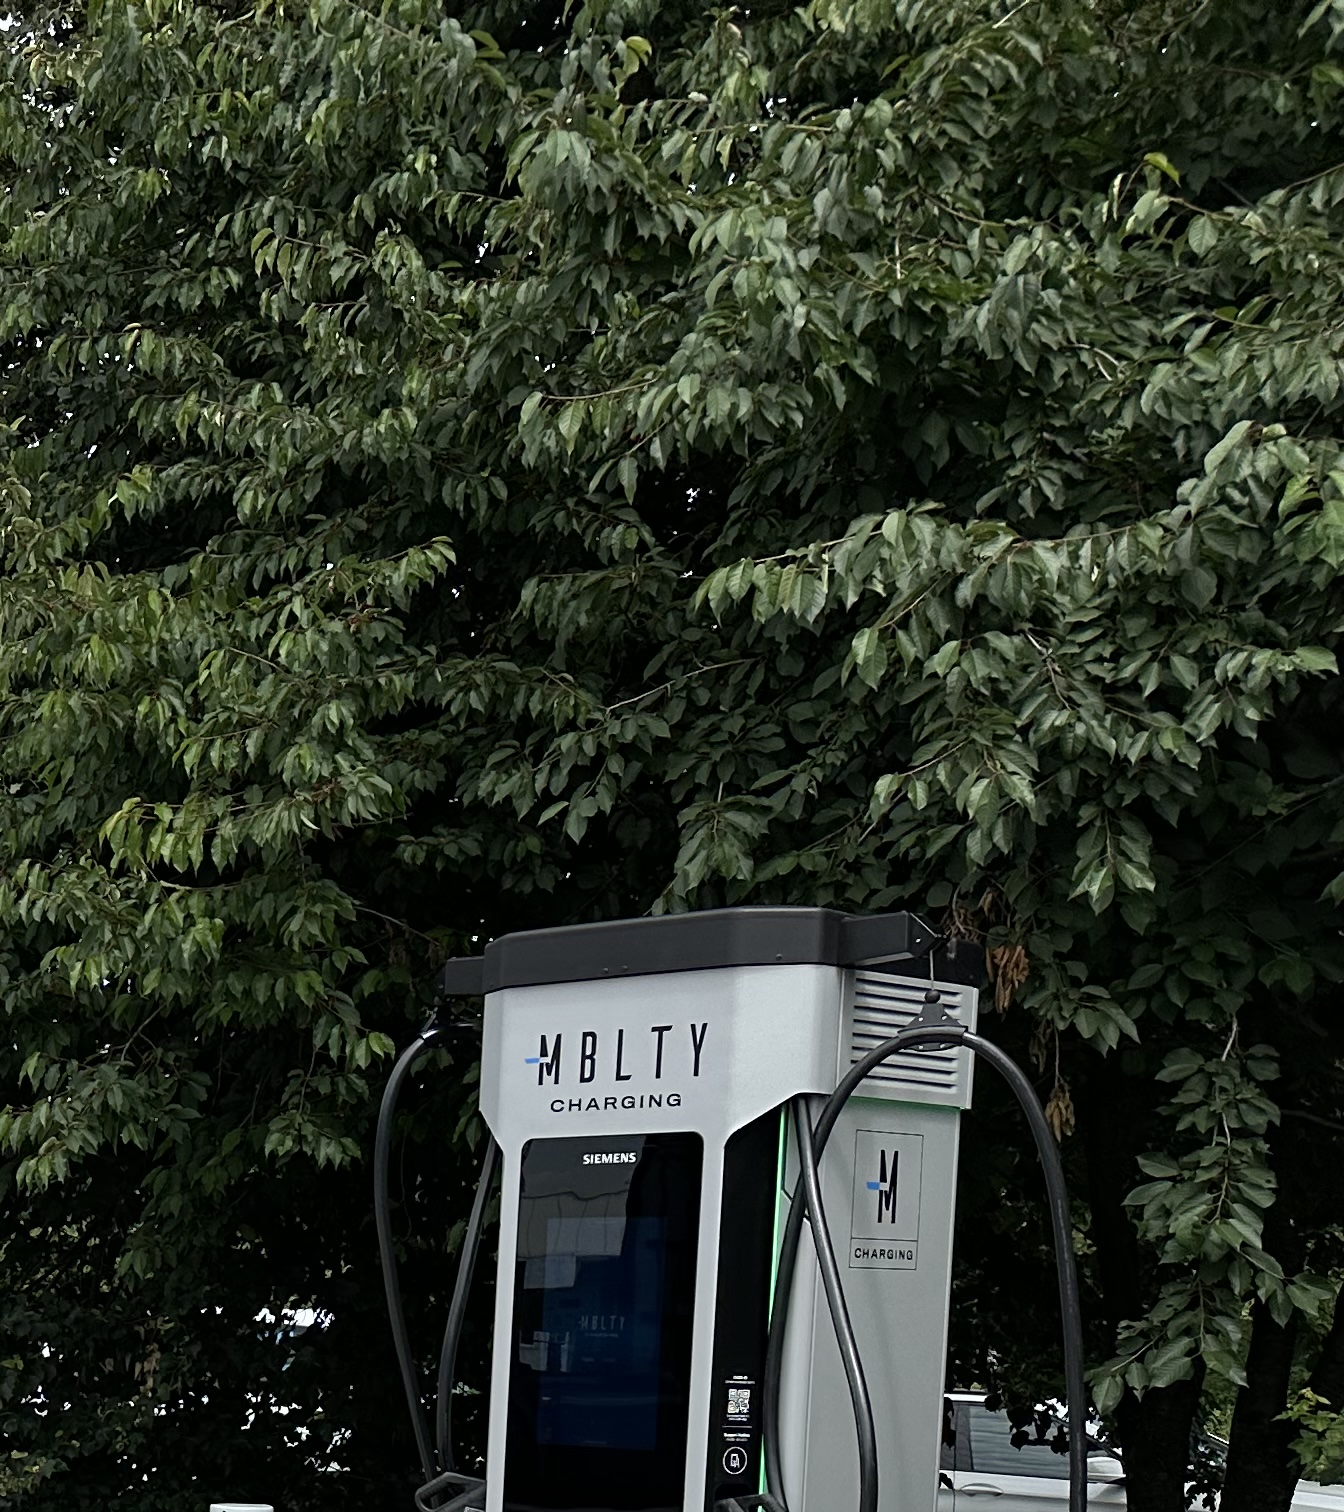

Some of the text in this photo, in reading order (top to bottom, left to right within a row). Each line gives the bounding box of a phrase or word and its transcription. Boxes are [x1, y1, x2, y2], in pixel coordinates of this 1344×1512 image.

[525, 1023, 708, 1086] MBLTY
[550, 1093, 682, 1113] CHARGING
[583, 1152, 637, 1165] SIEMENS
[854, 1248, 913, 1261] CHARGING
